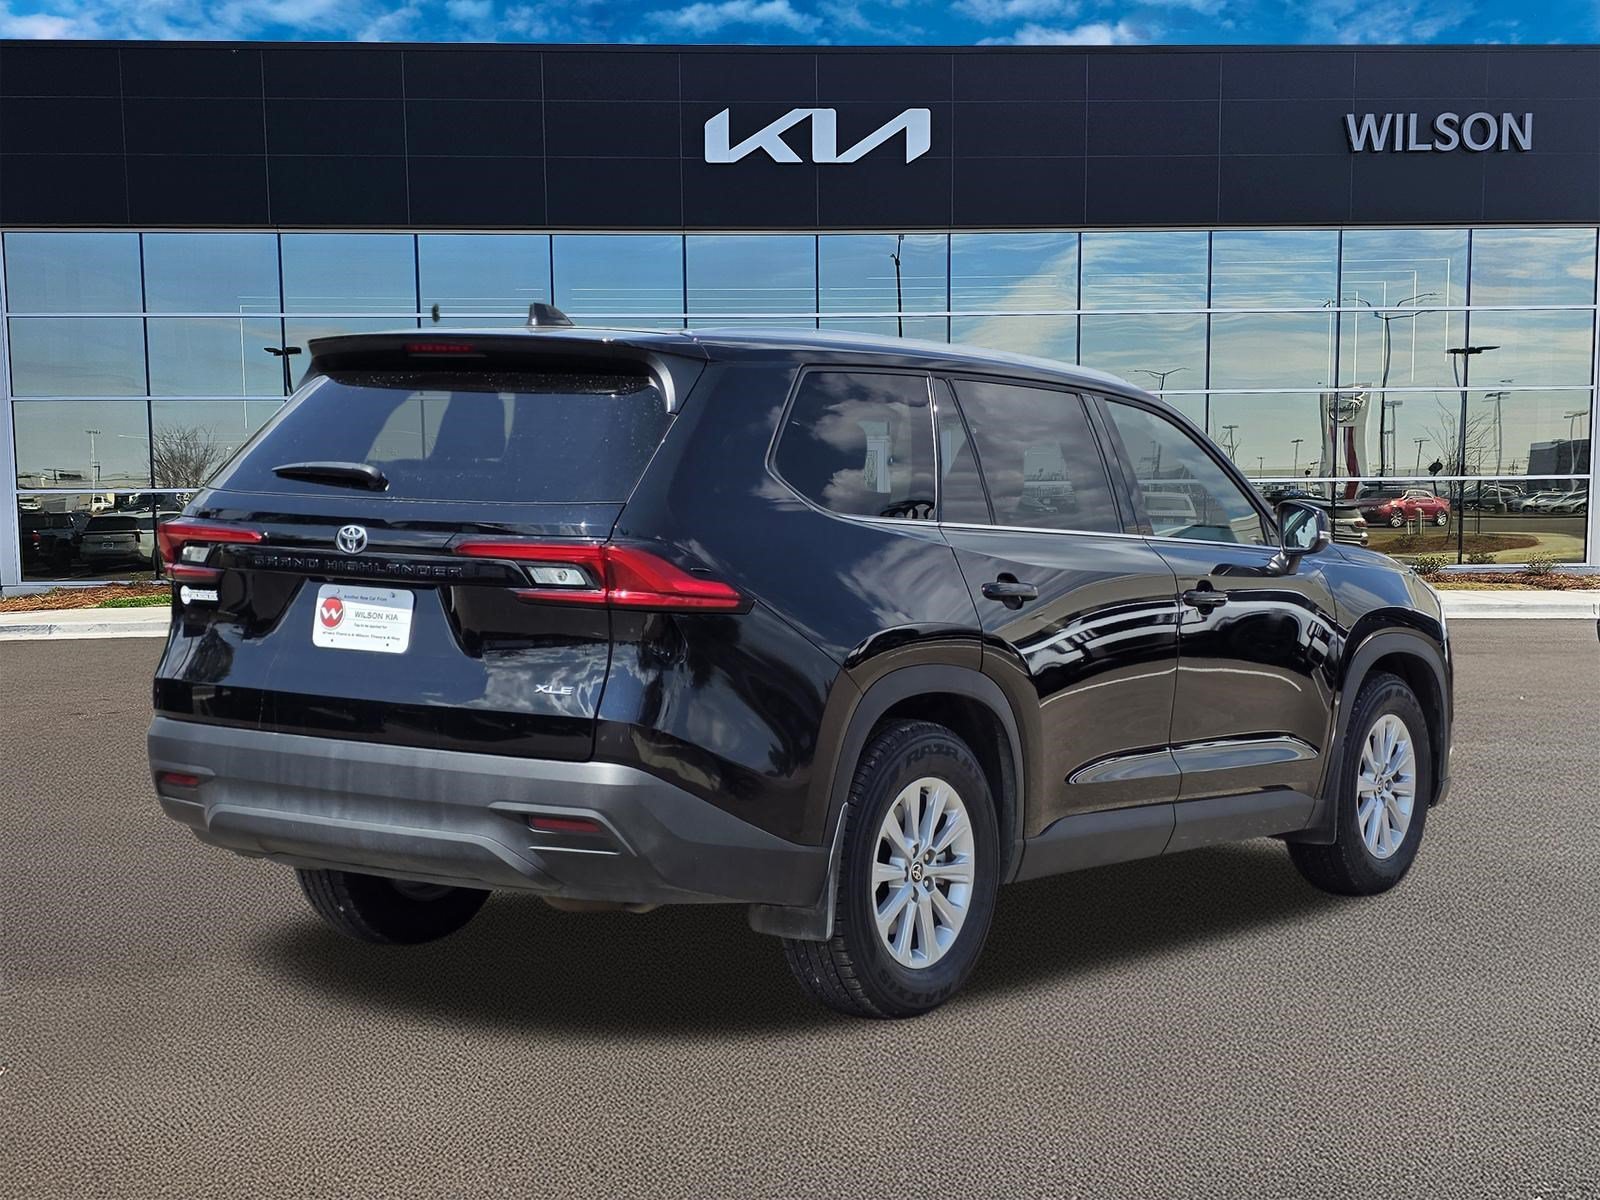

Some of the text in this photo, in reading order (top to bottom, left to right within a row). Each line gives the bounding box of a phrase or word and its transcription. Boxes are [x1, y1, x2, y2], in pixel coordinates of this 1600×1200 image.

[705, 108, 931, 163] KIA
[1345, 112, 1534, 151] WILSON
[254, 555, 464, 577] GRAND HIGHLANDER
[354, 610, 399, 621] WILSON KIA
[534, 684, 575, 695] XLE
